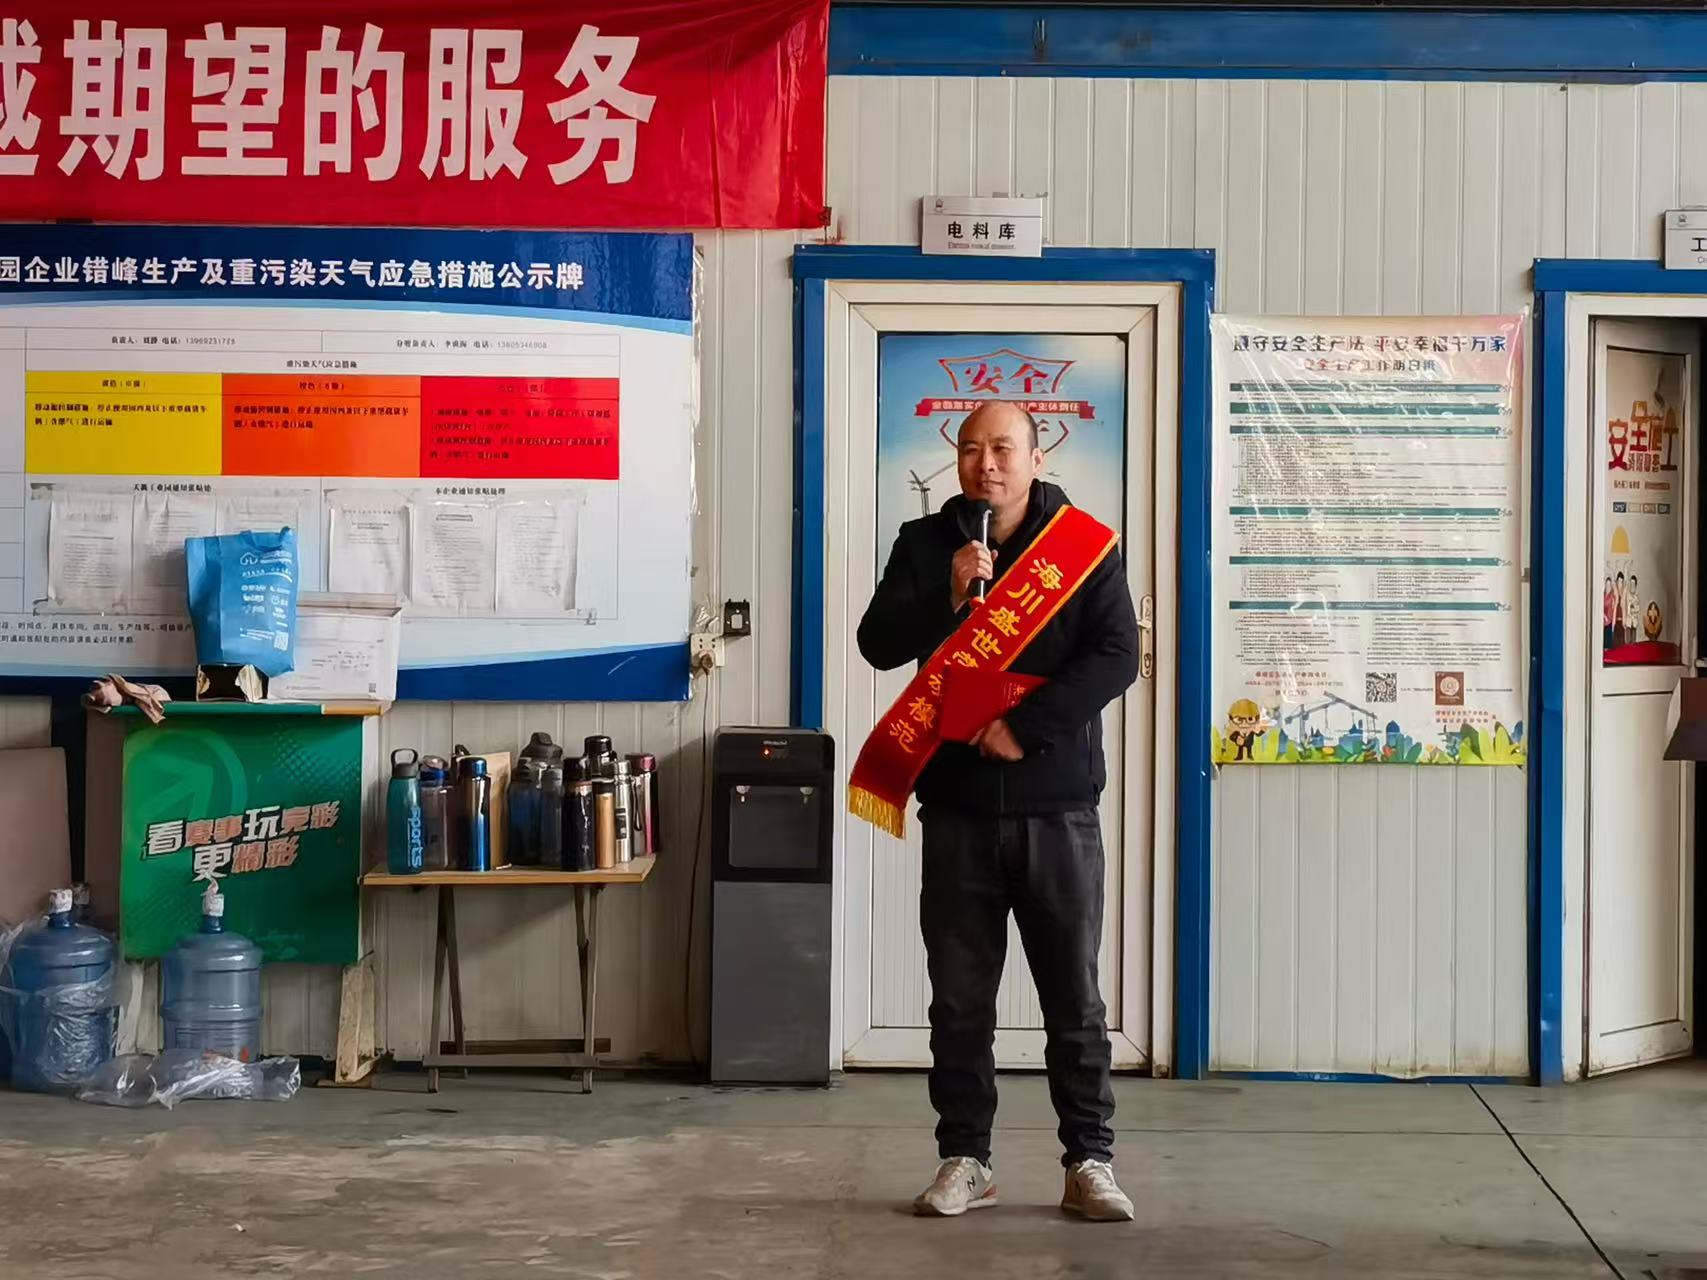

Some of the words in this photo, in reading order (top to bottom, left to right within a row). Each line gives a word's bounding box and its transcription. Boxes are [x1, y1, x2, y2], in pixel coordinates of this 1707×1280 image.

[947, 221, 1016, 240] 电料库
[0, 256, 585, 291] 园企业错峰生产及重污染天气应急措施公示牌
[963, 363, 1050, 394] 安全
